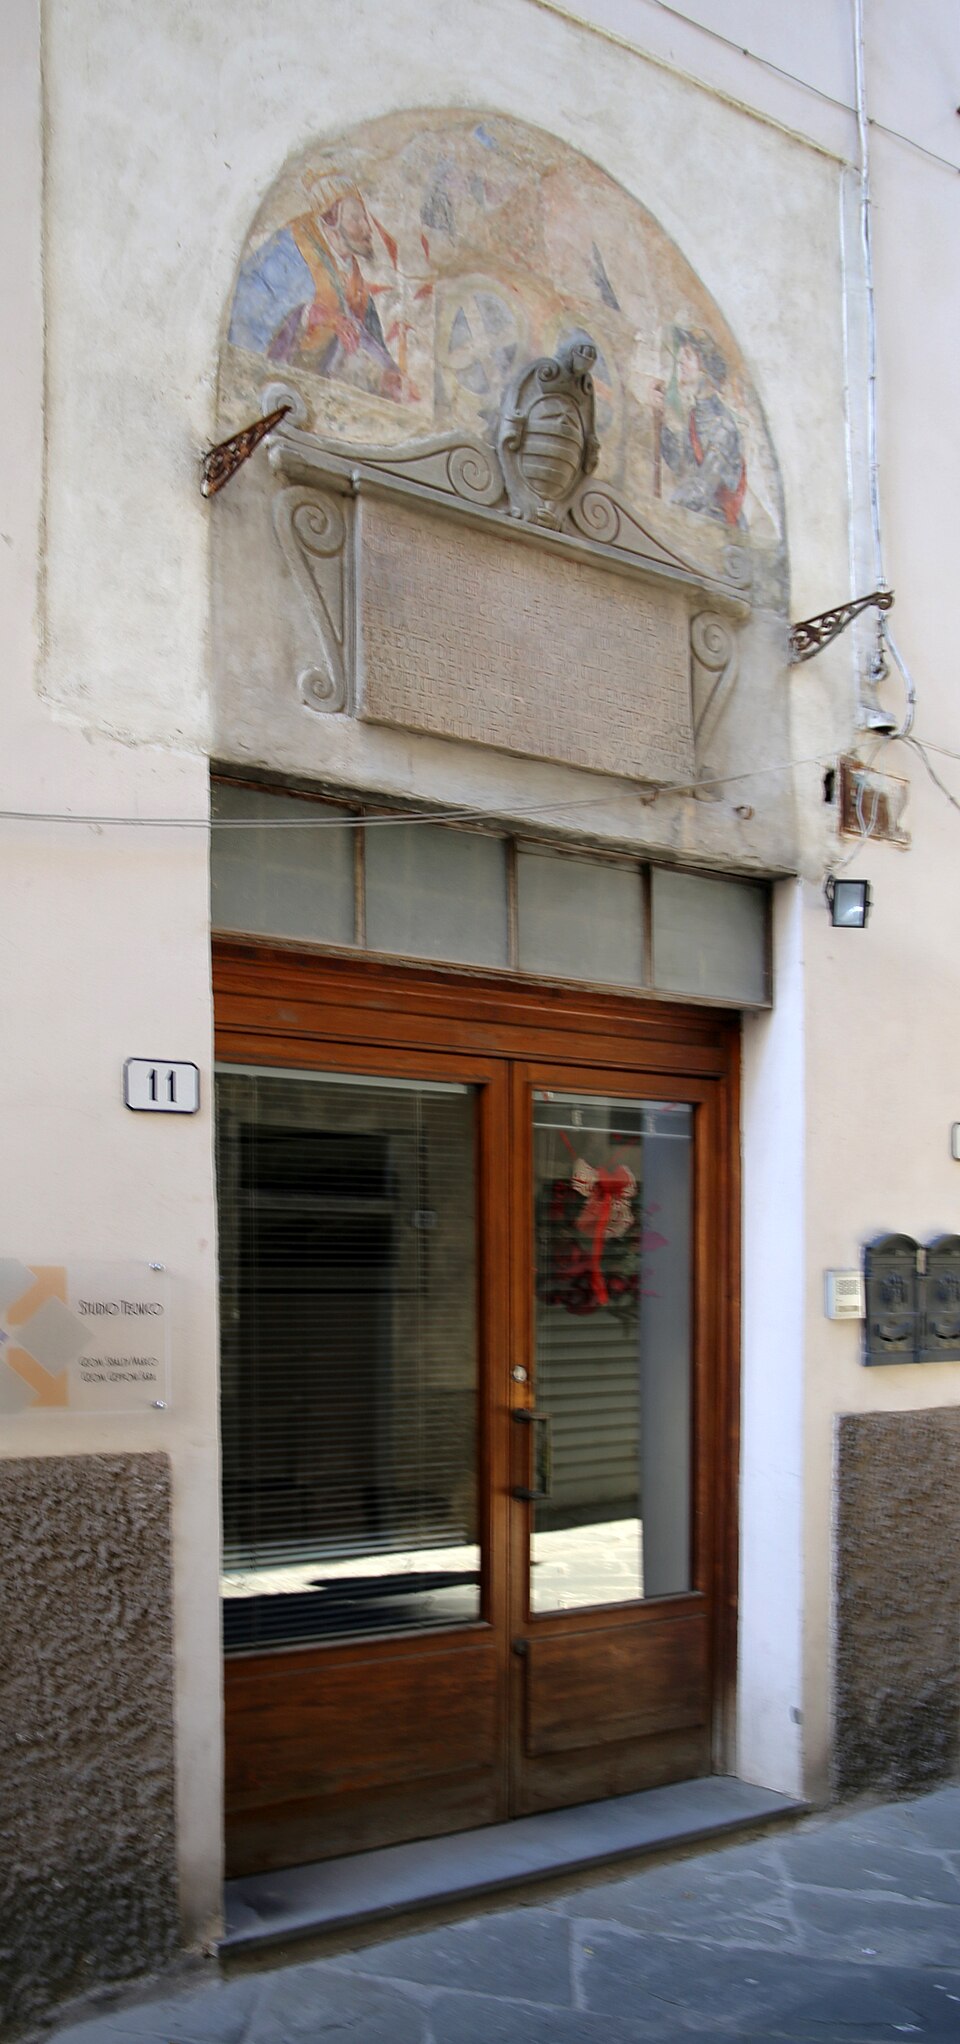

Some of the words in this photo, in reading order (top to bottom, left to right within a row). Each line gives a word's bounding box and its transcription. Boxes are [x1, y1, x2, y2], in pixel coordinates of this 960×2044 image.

[146, 1068, 177, 1103] 11
[78, 1299, 119, 1316] STUDIO
[120, 1299, 164, 1316] TECNICO
